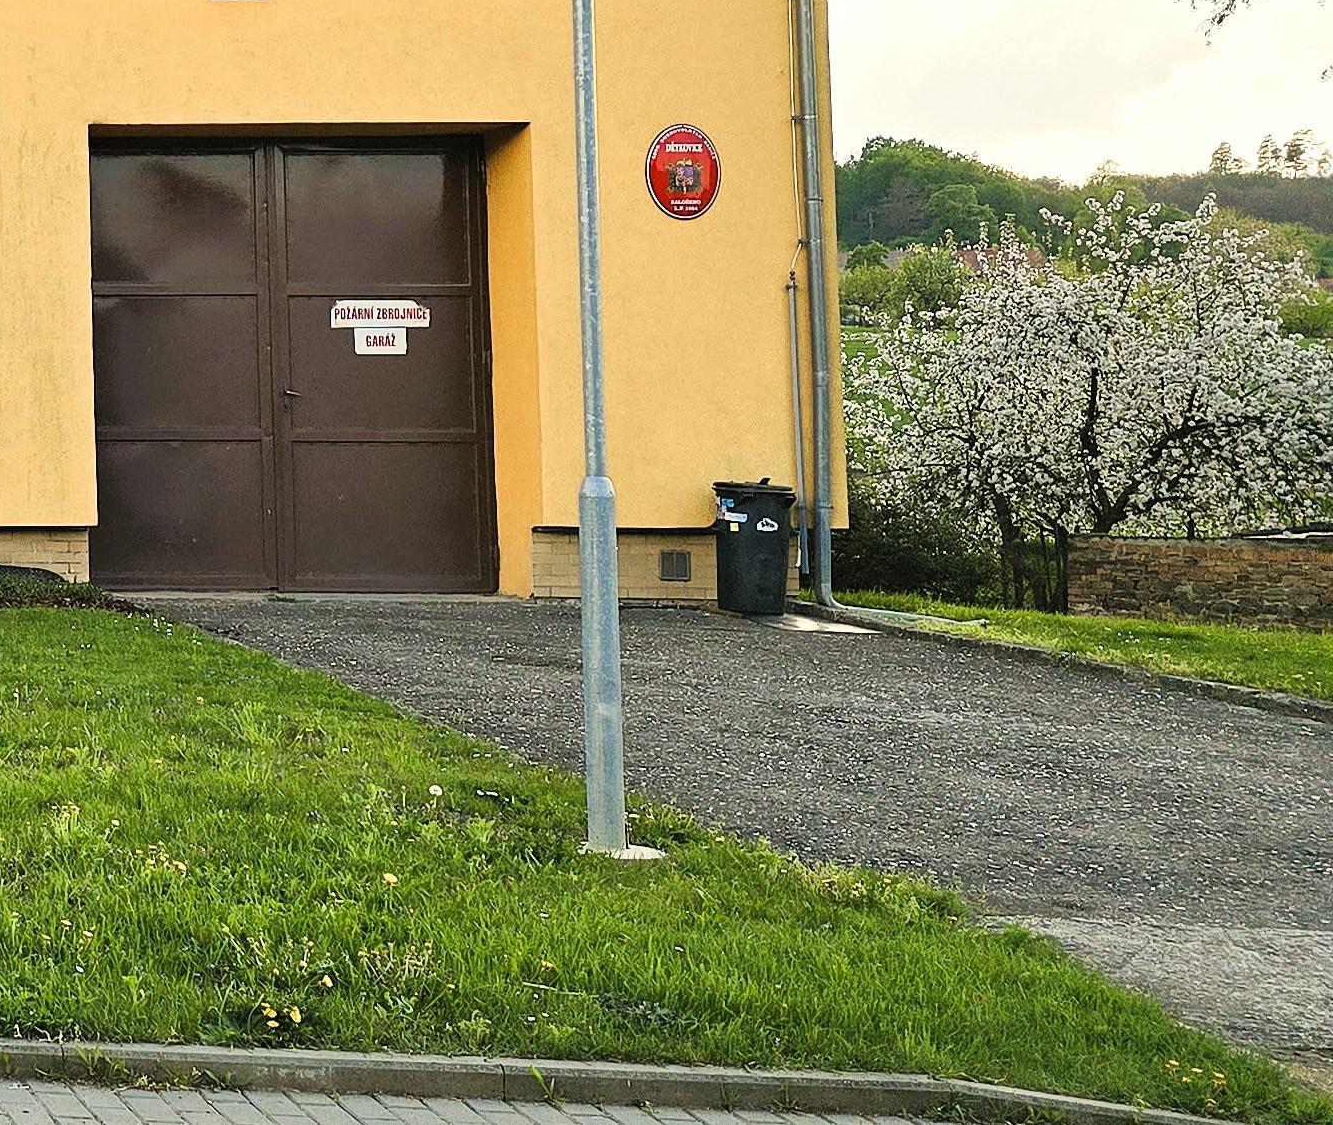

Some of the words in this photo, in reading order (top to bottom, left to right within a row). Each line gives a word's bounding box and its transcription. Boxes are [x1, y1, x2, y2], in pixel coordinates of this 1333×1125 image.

[334, 306, 374, 320] POŽÁRNÍ
[376, 307, 428, 320] ZBROJNICE
[365, 333, 397, 347] GARÁŽ
